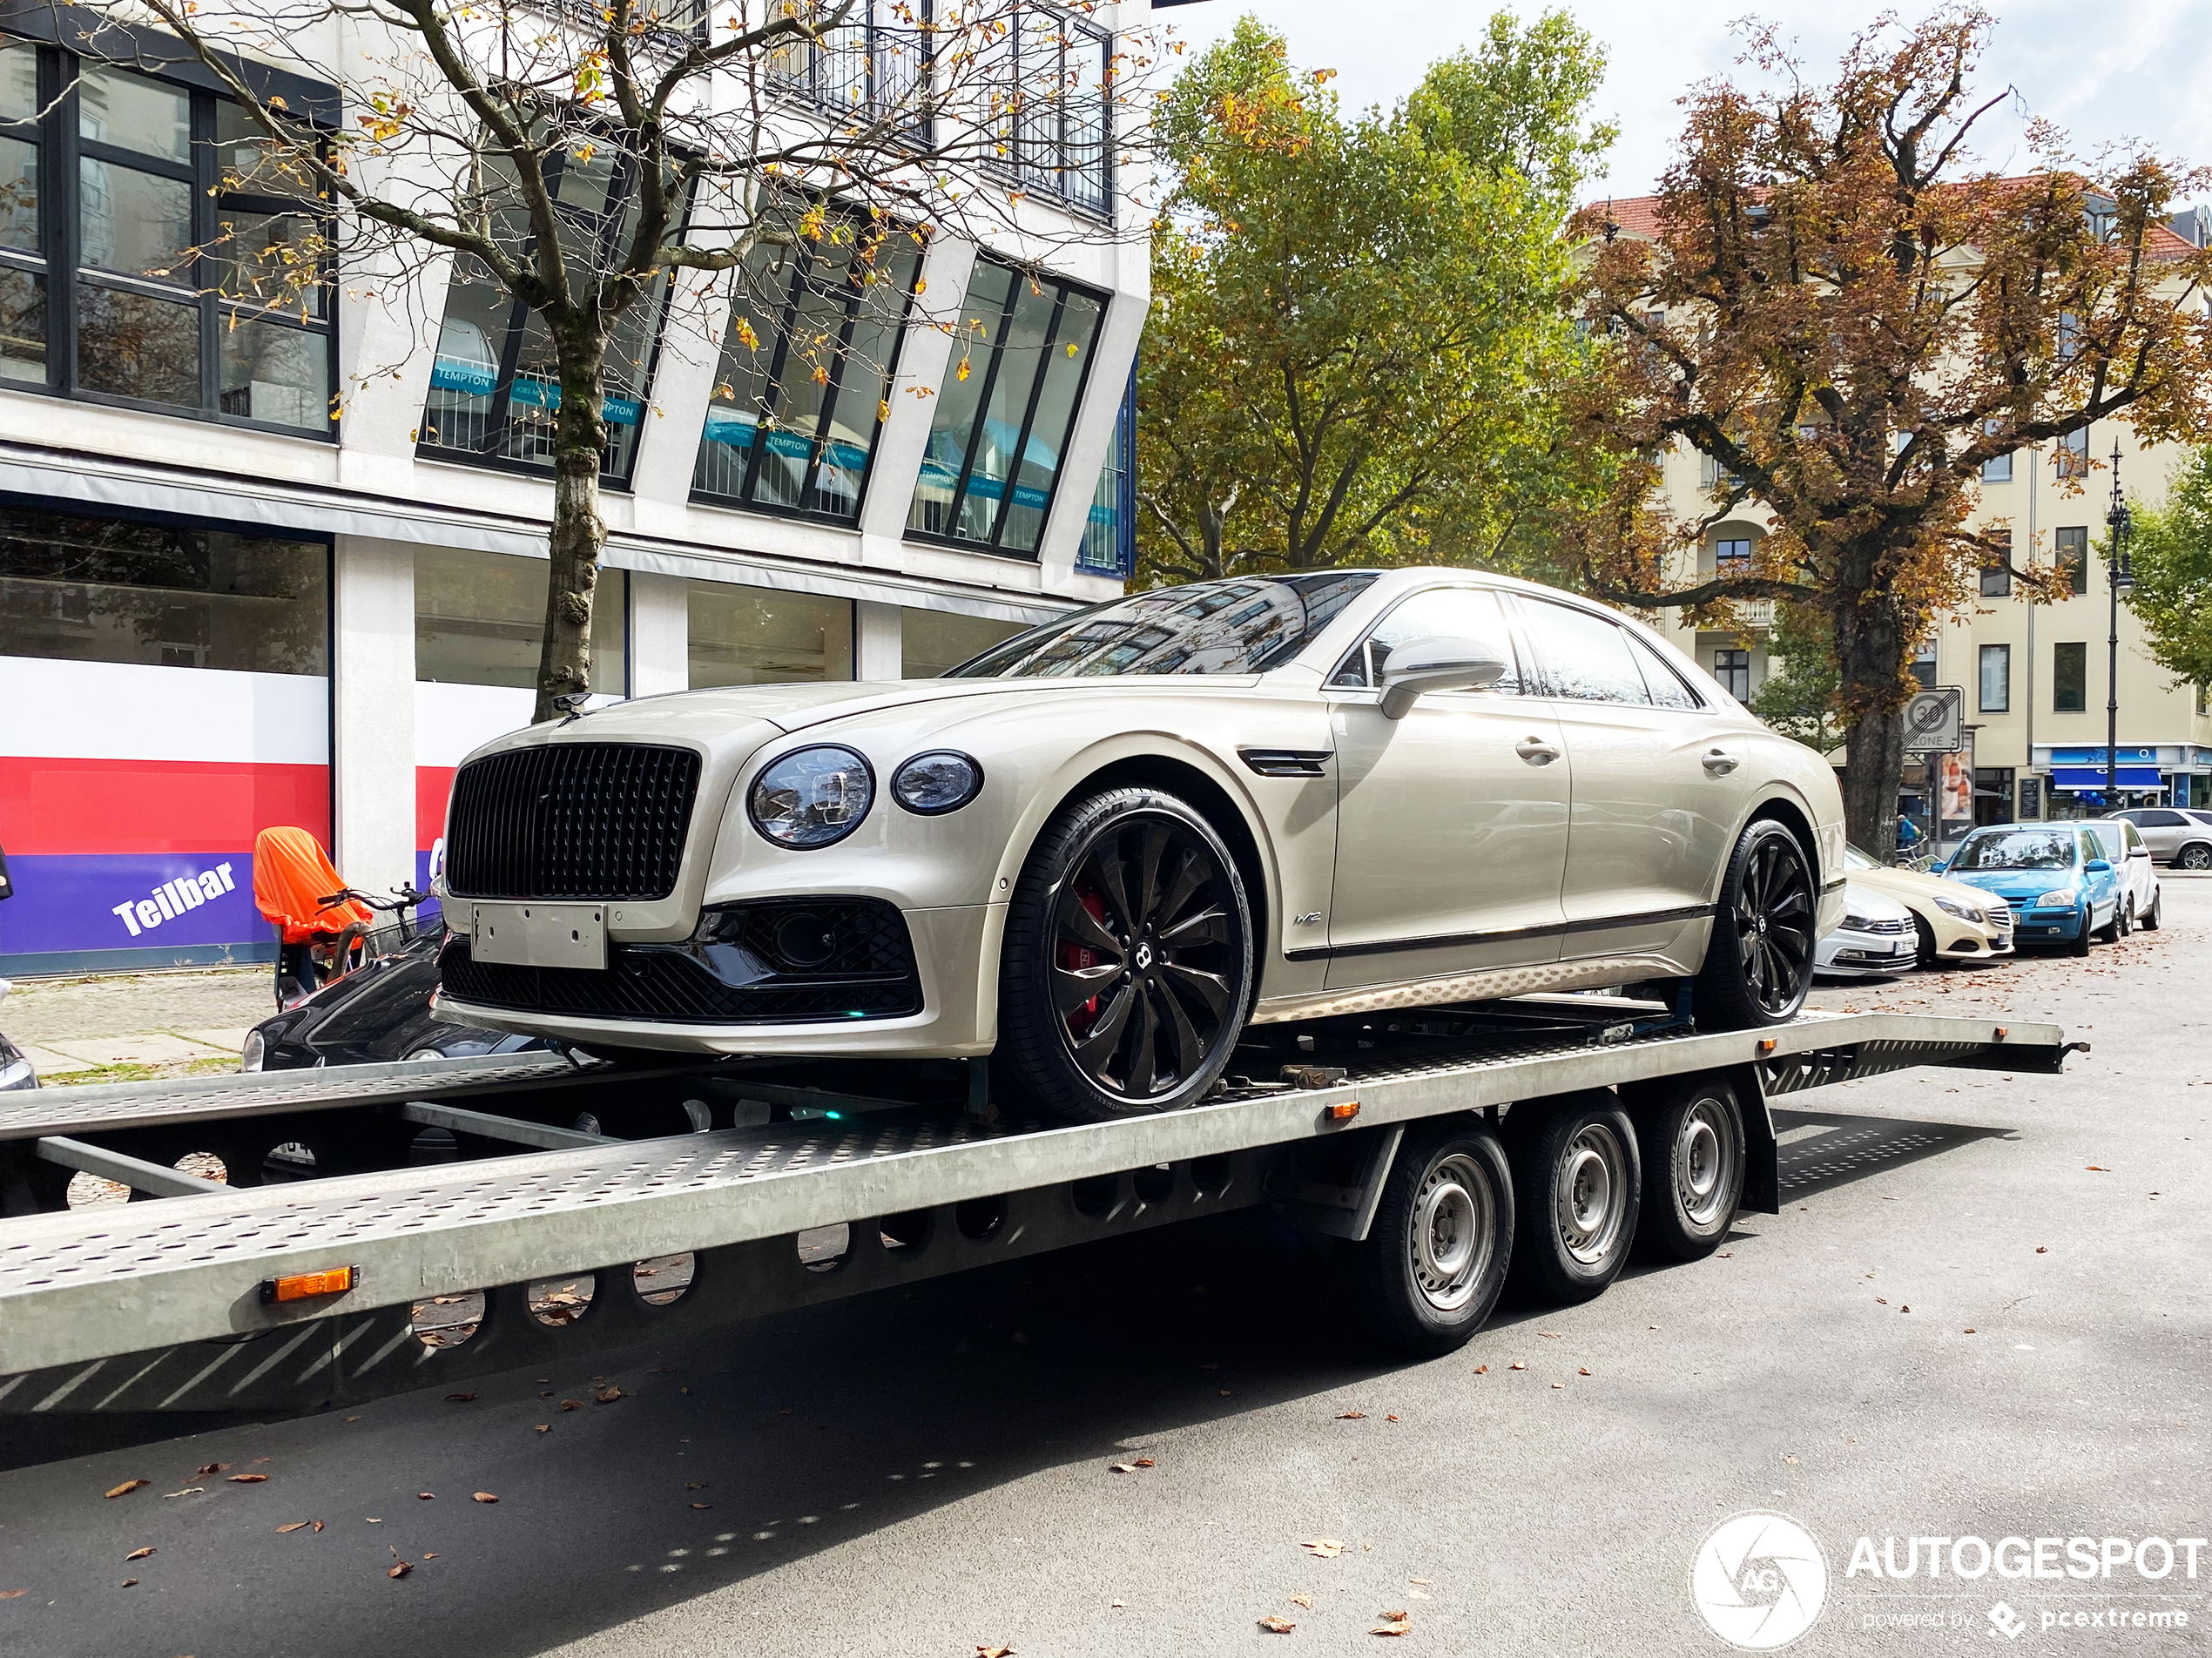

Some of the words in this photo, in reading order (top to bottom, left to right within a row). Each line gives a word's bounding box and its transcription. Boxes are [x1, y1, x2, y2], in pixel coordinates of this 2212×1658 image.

[438, 369, 489, 388] TEMPTON
[603, 403, 634, 417] MPTON
[770, 436, 808, 452] TEMPTON
[922, 470, 954, 484] TEMPTON
[1015, 490, 1045, 503] TEMPTON
[1912, 736, 1944, 746] ZONE
[111, 861, 236, 937] Teilbar
